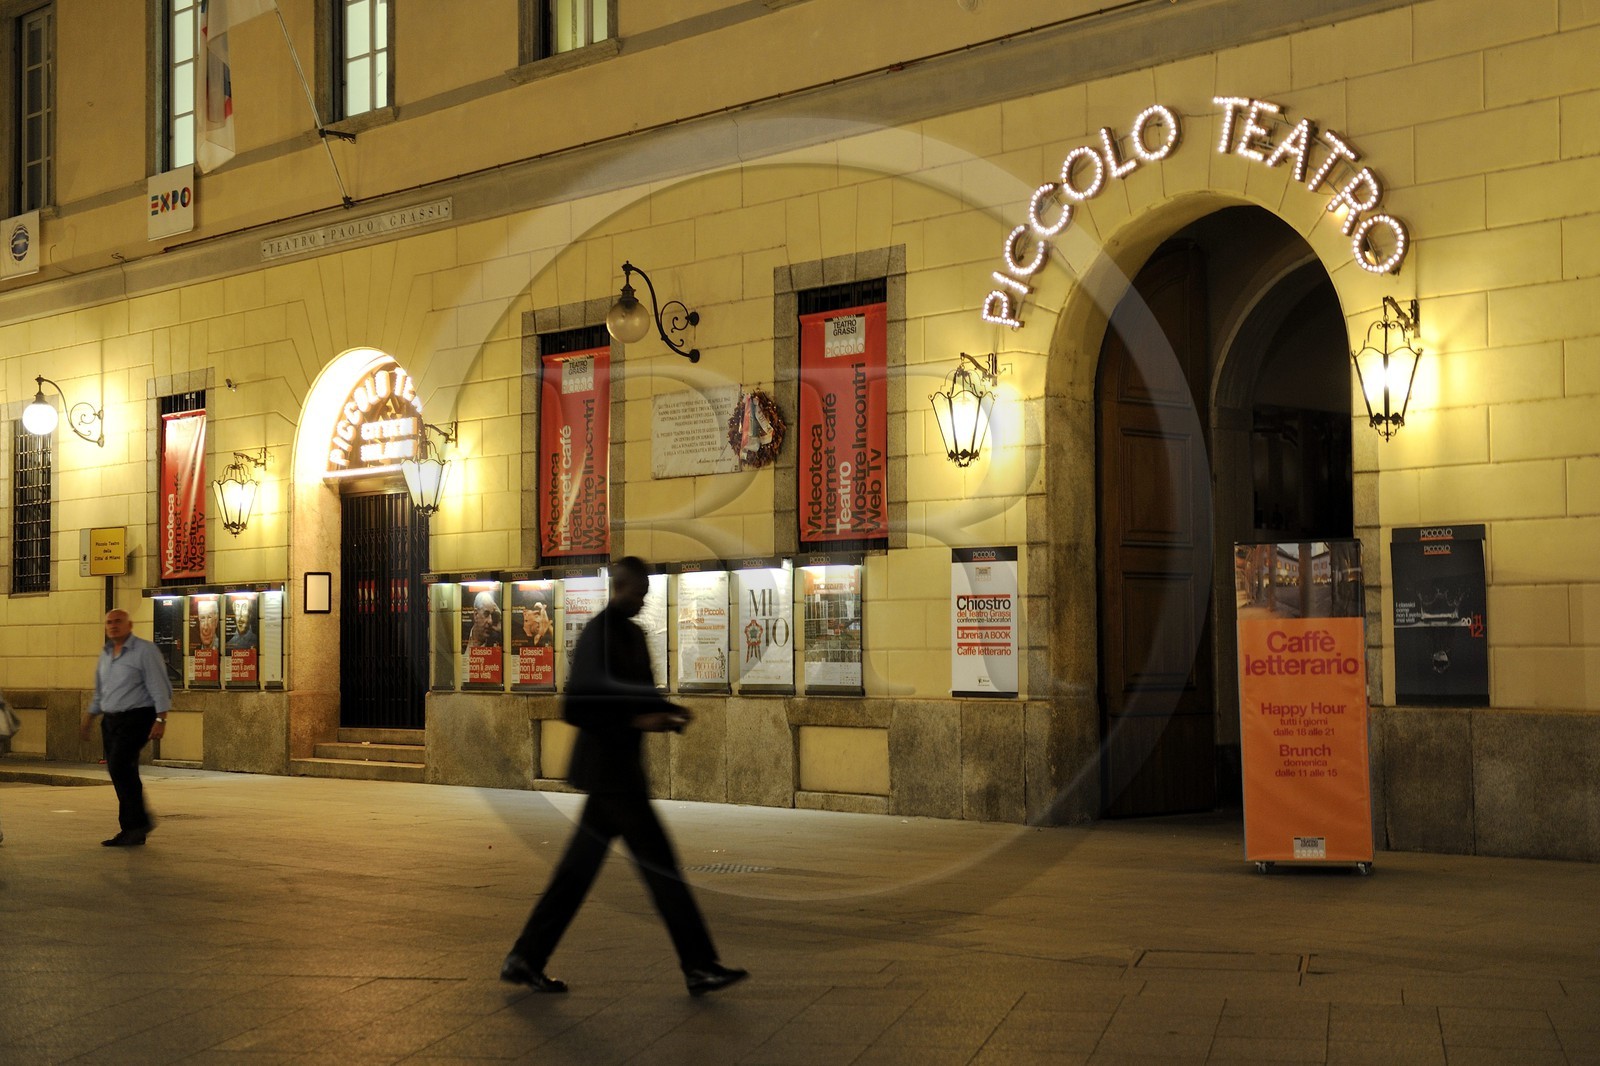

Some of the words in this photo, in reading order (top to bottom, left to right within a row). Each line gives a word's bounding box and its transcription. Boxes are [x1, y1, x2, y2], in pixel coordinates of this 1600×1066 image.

[151, 187, 191, 216] EXPO
[982, 104, 1182, 328] PICCOLO
[1212, 96, 1411, 274] TEATRO
[268, 236, 317, 254] TEATRO
[330, 221, 374, 240] PAOLO
[389, 205, 442, 226] GRASSI
[833, 319, 857, 330] TEATRO
[833, 327, 857, 337] GRASSI
[330, 370, 391, 466] PICCOLO
[822, 392, 837, 442] café
[851, 362, 867, 449] Incontri
[559, 425, 572, 469] café
[582, 398, 595, 474] Incontri
[866, 448, 883, 477] Tv
[594, 475, 606, 496] Tv
[807, 423, 823, 536] Videoteca
[822, 445, 837, 535] Internet
[851, 450, 867, 533] Mostre
[548, 452, 560, 554] Videoteca
[559, 473, 572, 551] Internet
[582, 475, 595, 550] Mostre
[835, 461, 852, 535] Teatro
[866, 480, 883, 533] Web
[165, 494, 175, 576] Videoteca
[173, 509, 183, 573] Internet
[593, 504, 607, 550] Web
[1420, 529, 1453, 537] PICCOLO
[197, 535, 206, 571] Web
[749, 589, 772, 617] MI
[957, 595, 1011, 610] Chiostro
[759, 618, 789, 648] TO
[957, 630, 983, 639] Libreria
[990, 631, 1011, 639] BOOK
[1461, 618, 1472, 626] 20
[1469, 624, 1484, 638] 12
[473, 647, 492, 655] classici
[523, 647, 544, 655] classici
[957, 646, 976, 656] Caffè
[977, 646, 1012, 656] letterario
[1266, 630, 1336, 653] Caffè
[535, 664, 551, 672] avete
[1245, 652, 1360, 676] letterario
[1261, 702, 1307, 718] Happy
[1311, 702, 1347, 715] Hour
[1280, 717, 1297, 726] tutti
[1303, 717, 1328, 728] giorni
[1273, 728, 1294, 736] dalle
[1308, 728, 1323, 736] alle
[1325, 728, 1335, 736] 21
[1279, 744, 1332, 757] Brunch
[1284, 758, 1328, 767] domenica
[1275, 769, 1296, 778] dalle
[1298, 769, 1307, 777] 11
[1310, 769, 1325, 777] alle
[1327, 769, 1338, 777] 15
